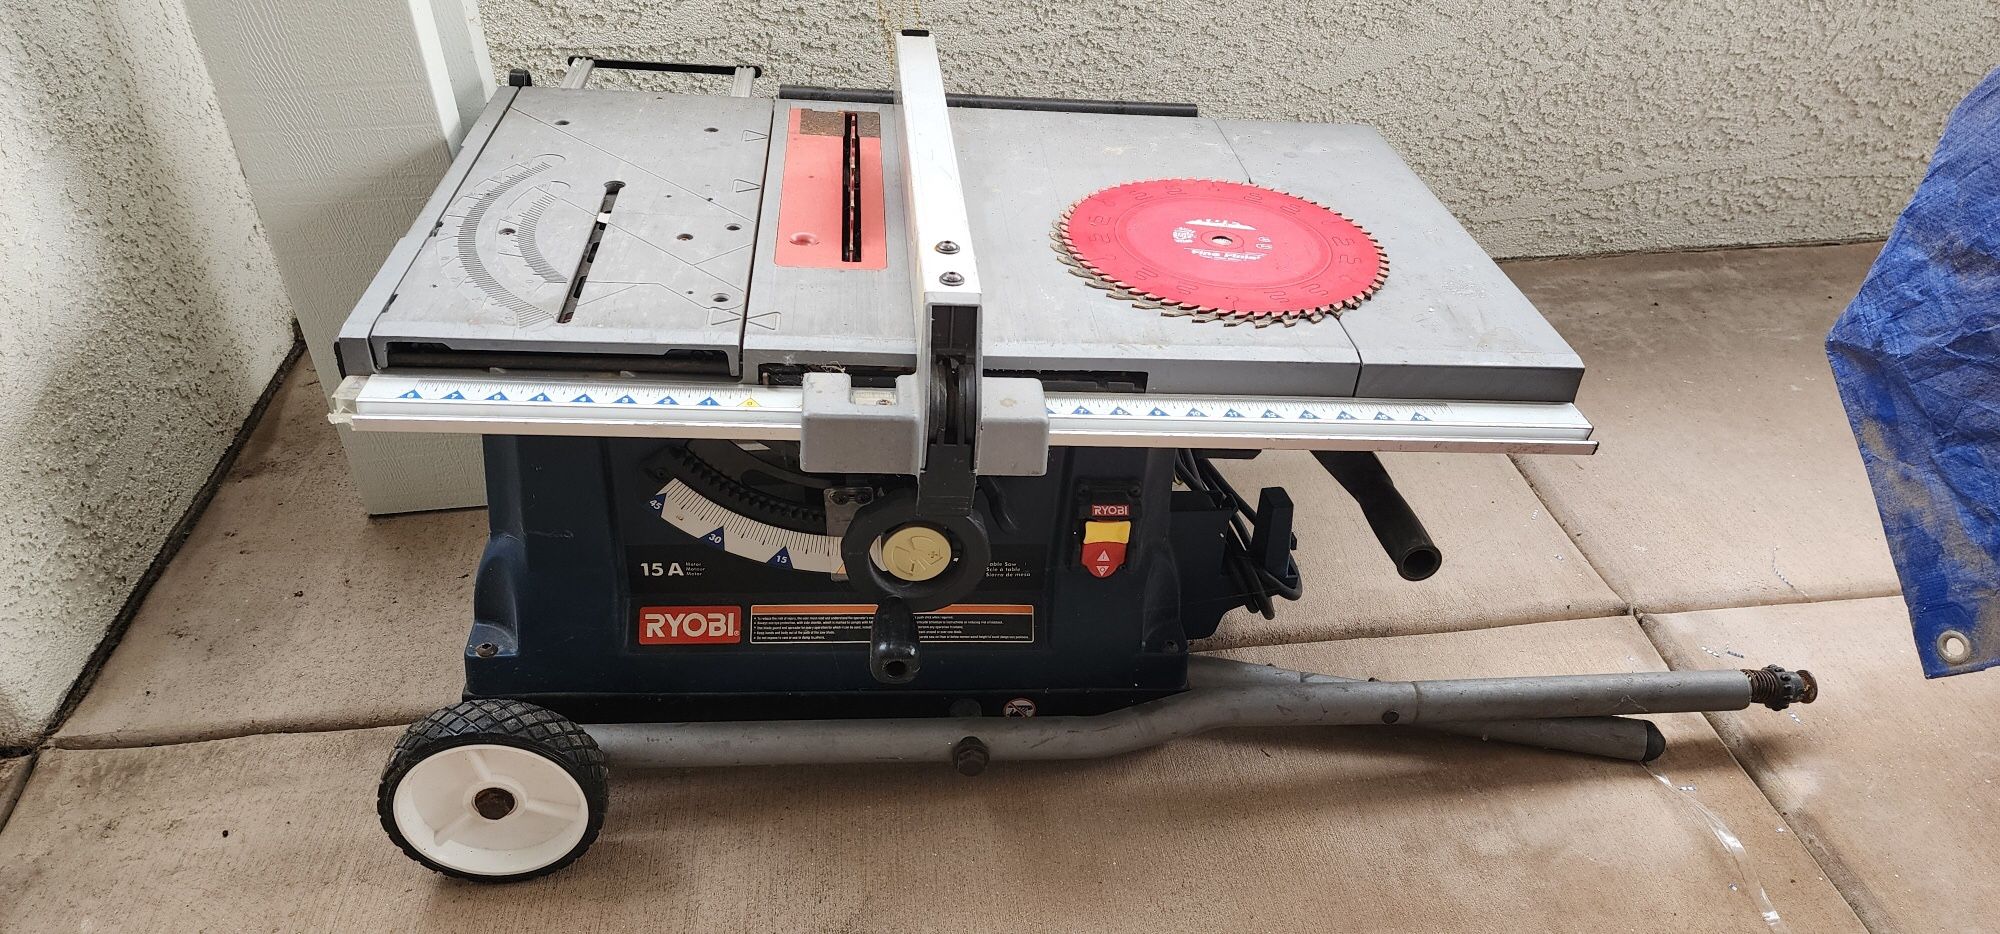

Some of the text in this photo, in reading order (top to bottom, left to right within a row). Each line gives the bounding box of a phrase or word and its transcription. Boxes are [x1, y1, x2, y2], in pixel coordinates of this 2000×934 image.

[1093, 505, 1128, 515] RYOBI
[649, 499, 788, 564] 45 30 15
[640, 562, 685, 577] 15 A
